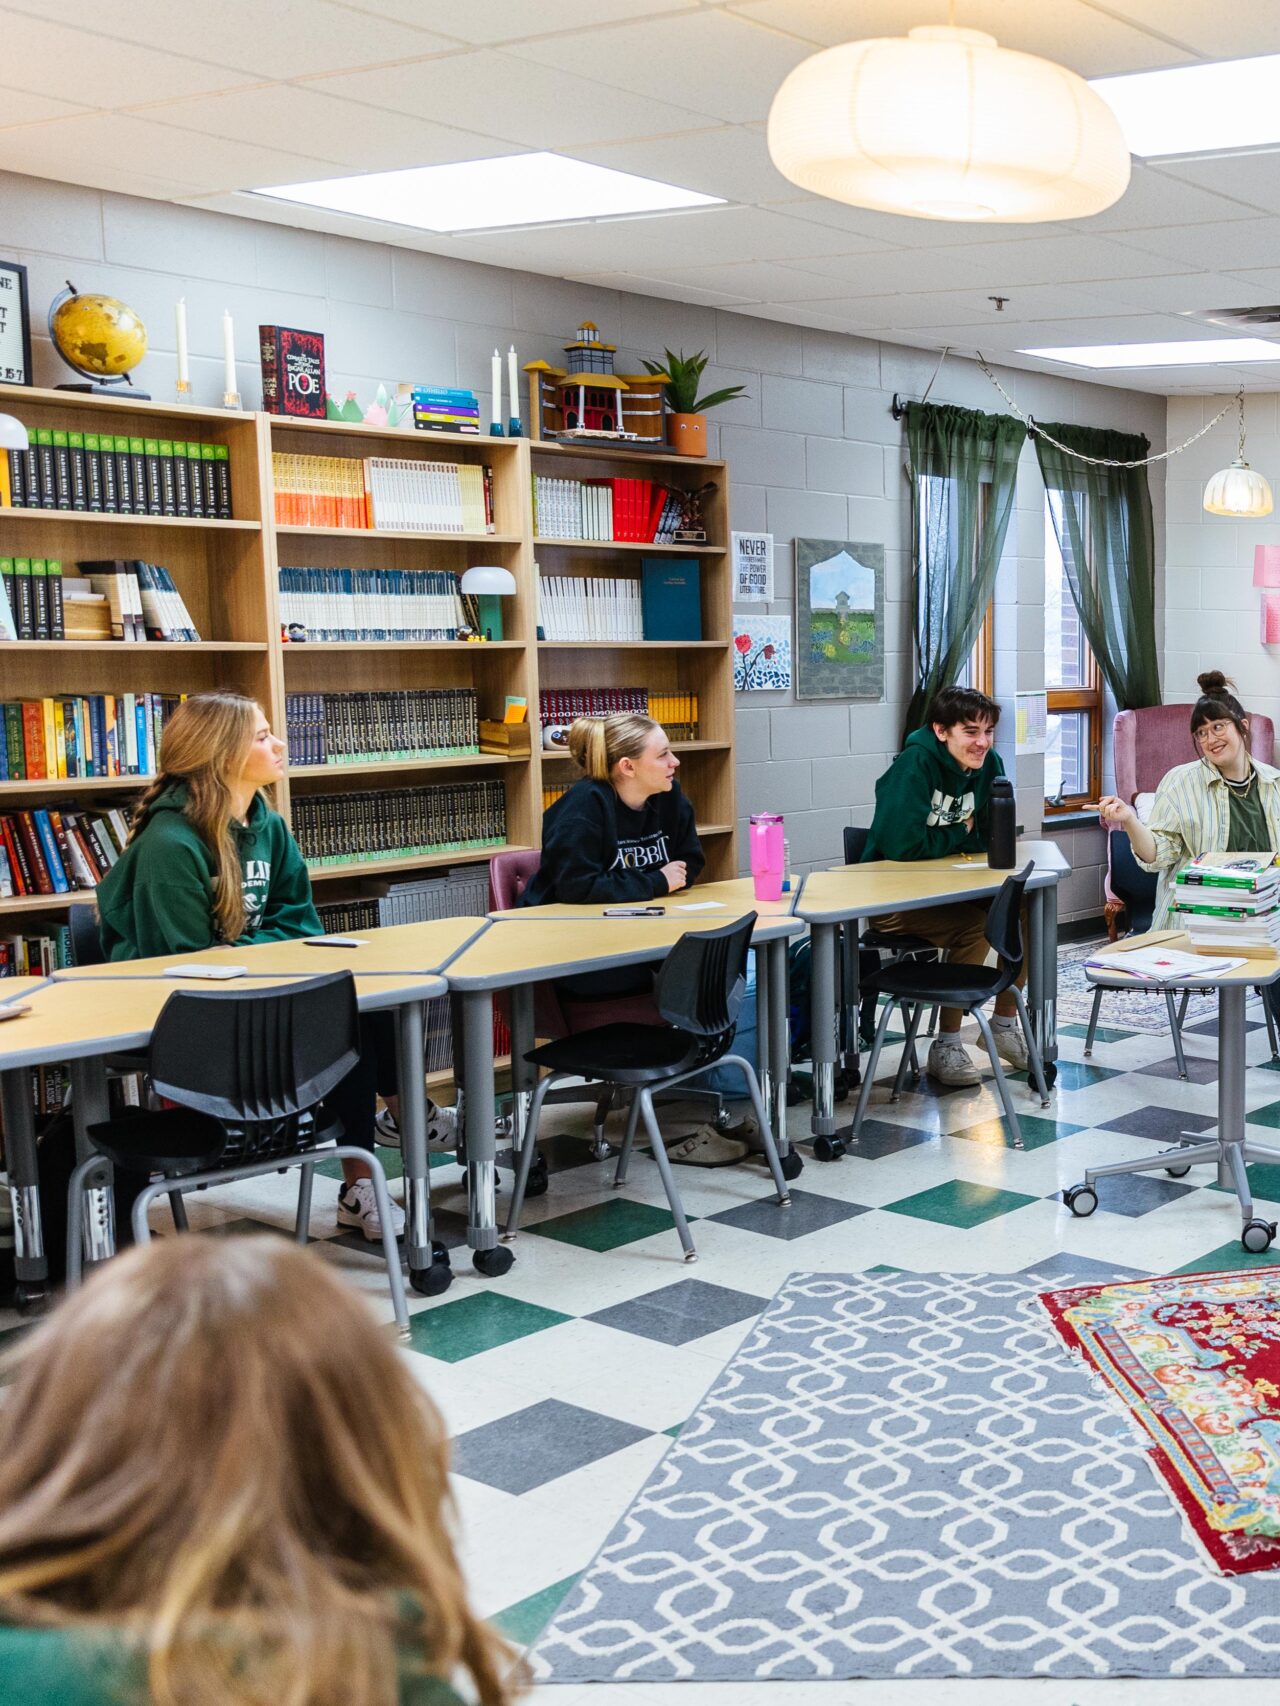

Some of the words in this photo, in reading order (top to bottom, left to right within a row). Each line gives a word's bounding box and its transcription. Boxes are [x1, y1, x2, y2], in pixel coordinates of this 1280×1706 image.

[288, 372, 320, 395] POE
[740, 539, 766, 556] NEVER
[750, 564, 766, 573] POWER
[740, 574, 748, 584] OF
[749, 574, 766, 585] GOOD
[94, 842, 102, 855] BOOK
[241, 880, 266, 888] DEMY
